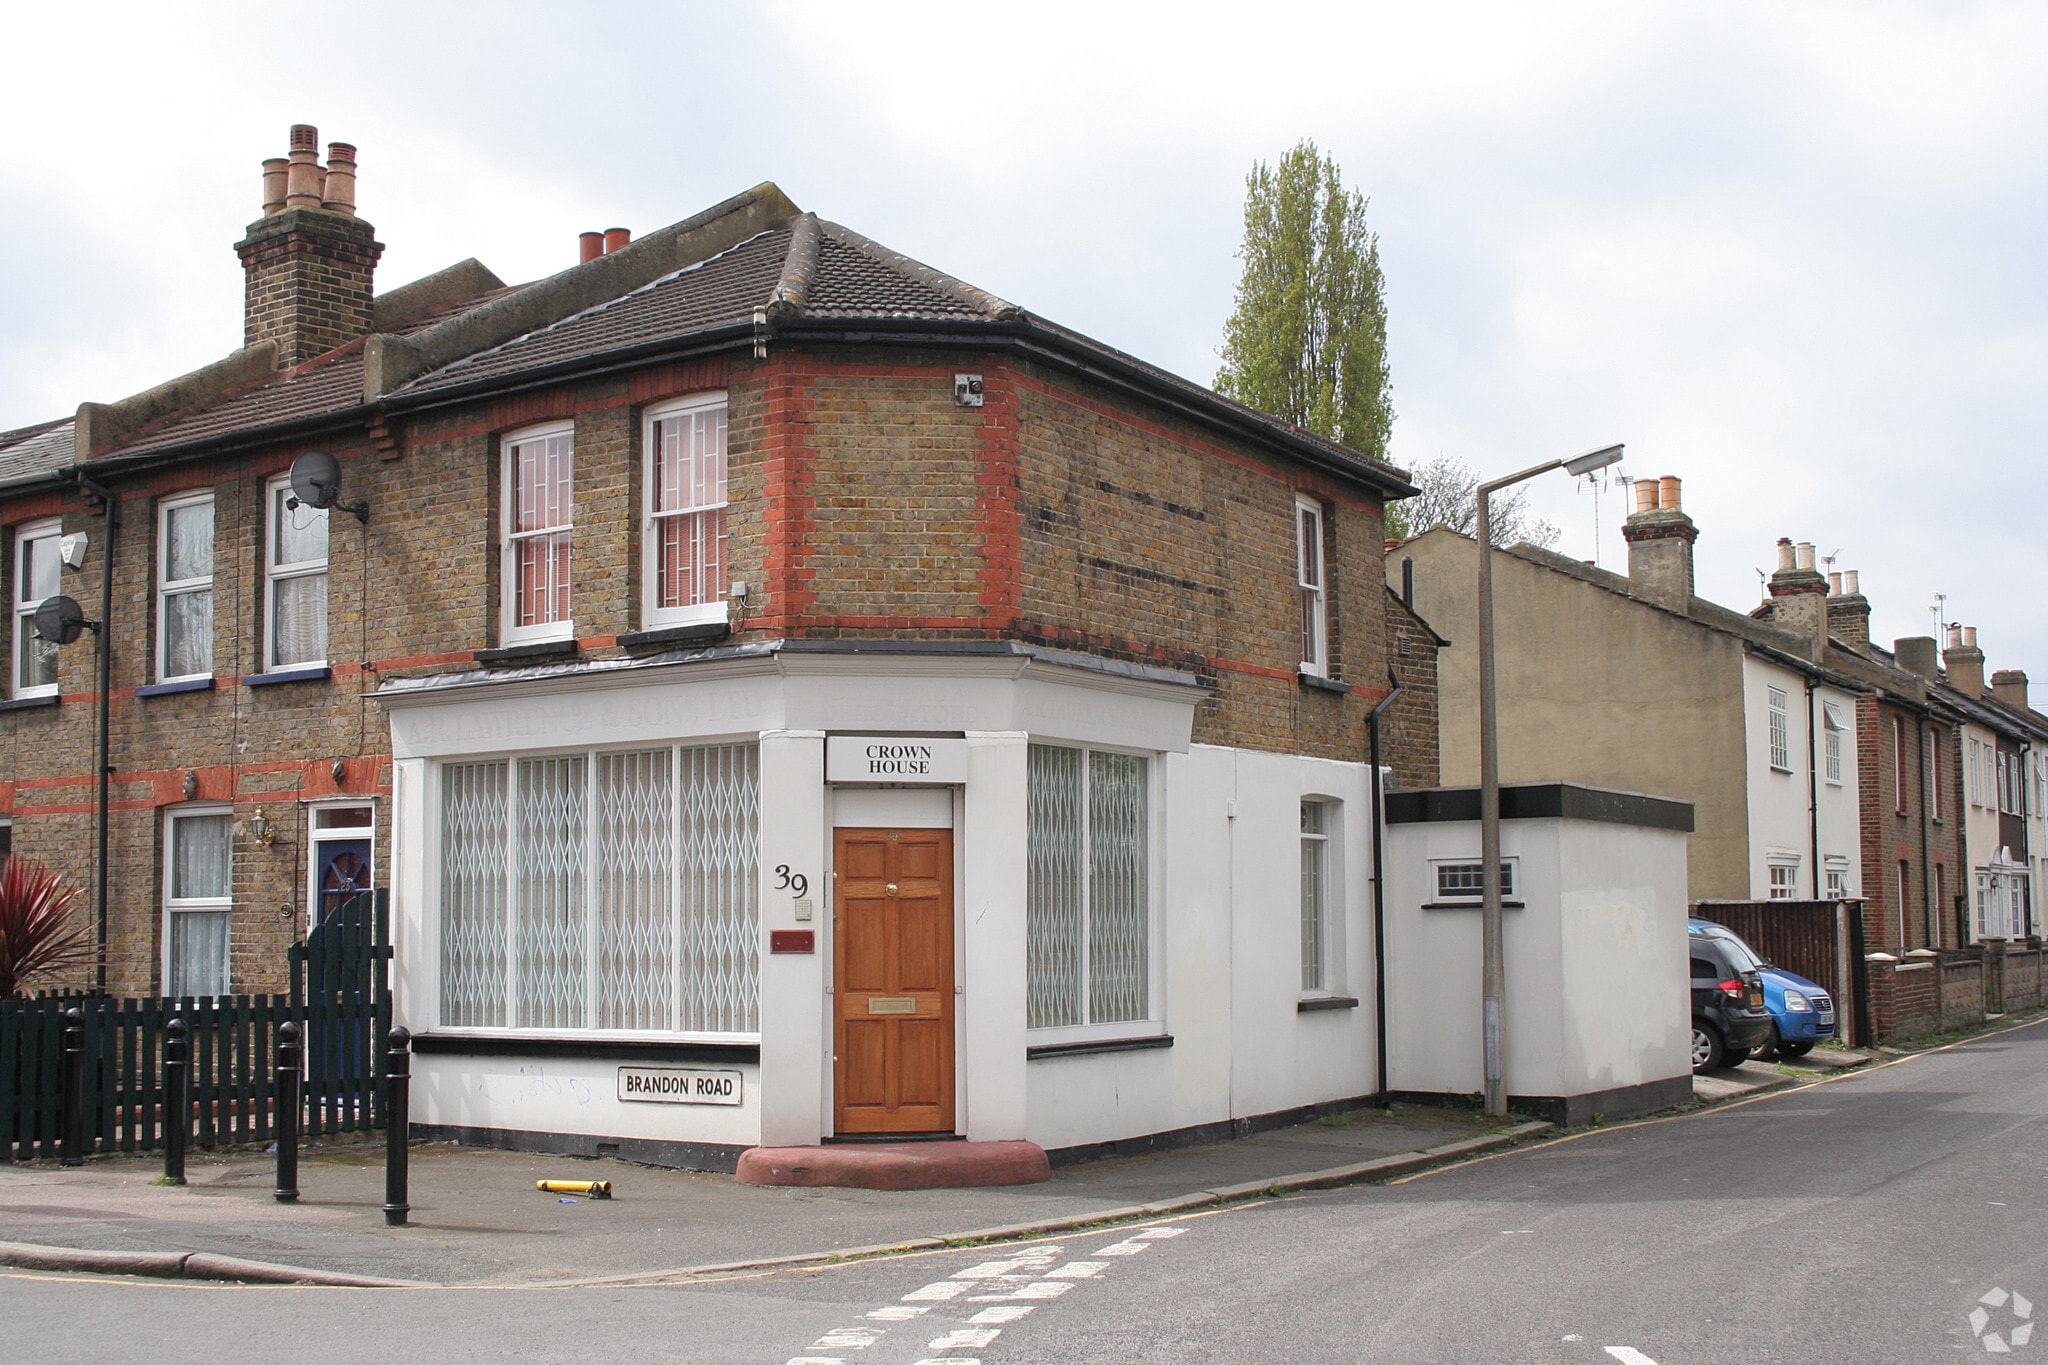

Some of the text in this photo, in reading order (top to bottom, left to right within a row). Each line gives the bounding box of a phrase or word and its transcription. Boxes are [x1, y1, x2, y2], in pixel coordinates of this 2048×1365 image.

[866, 744, 931, 759] CROWN
[869, 760, 929, 774] HOUSE
[340, 880, 351, 892] 23
[774, 864, 808, 899] 39
[626, 1075, 733, 1096] BRANDON ROAD
